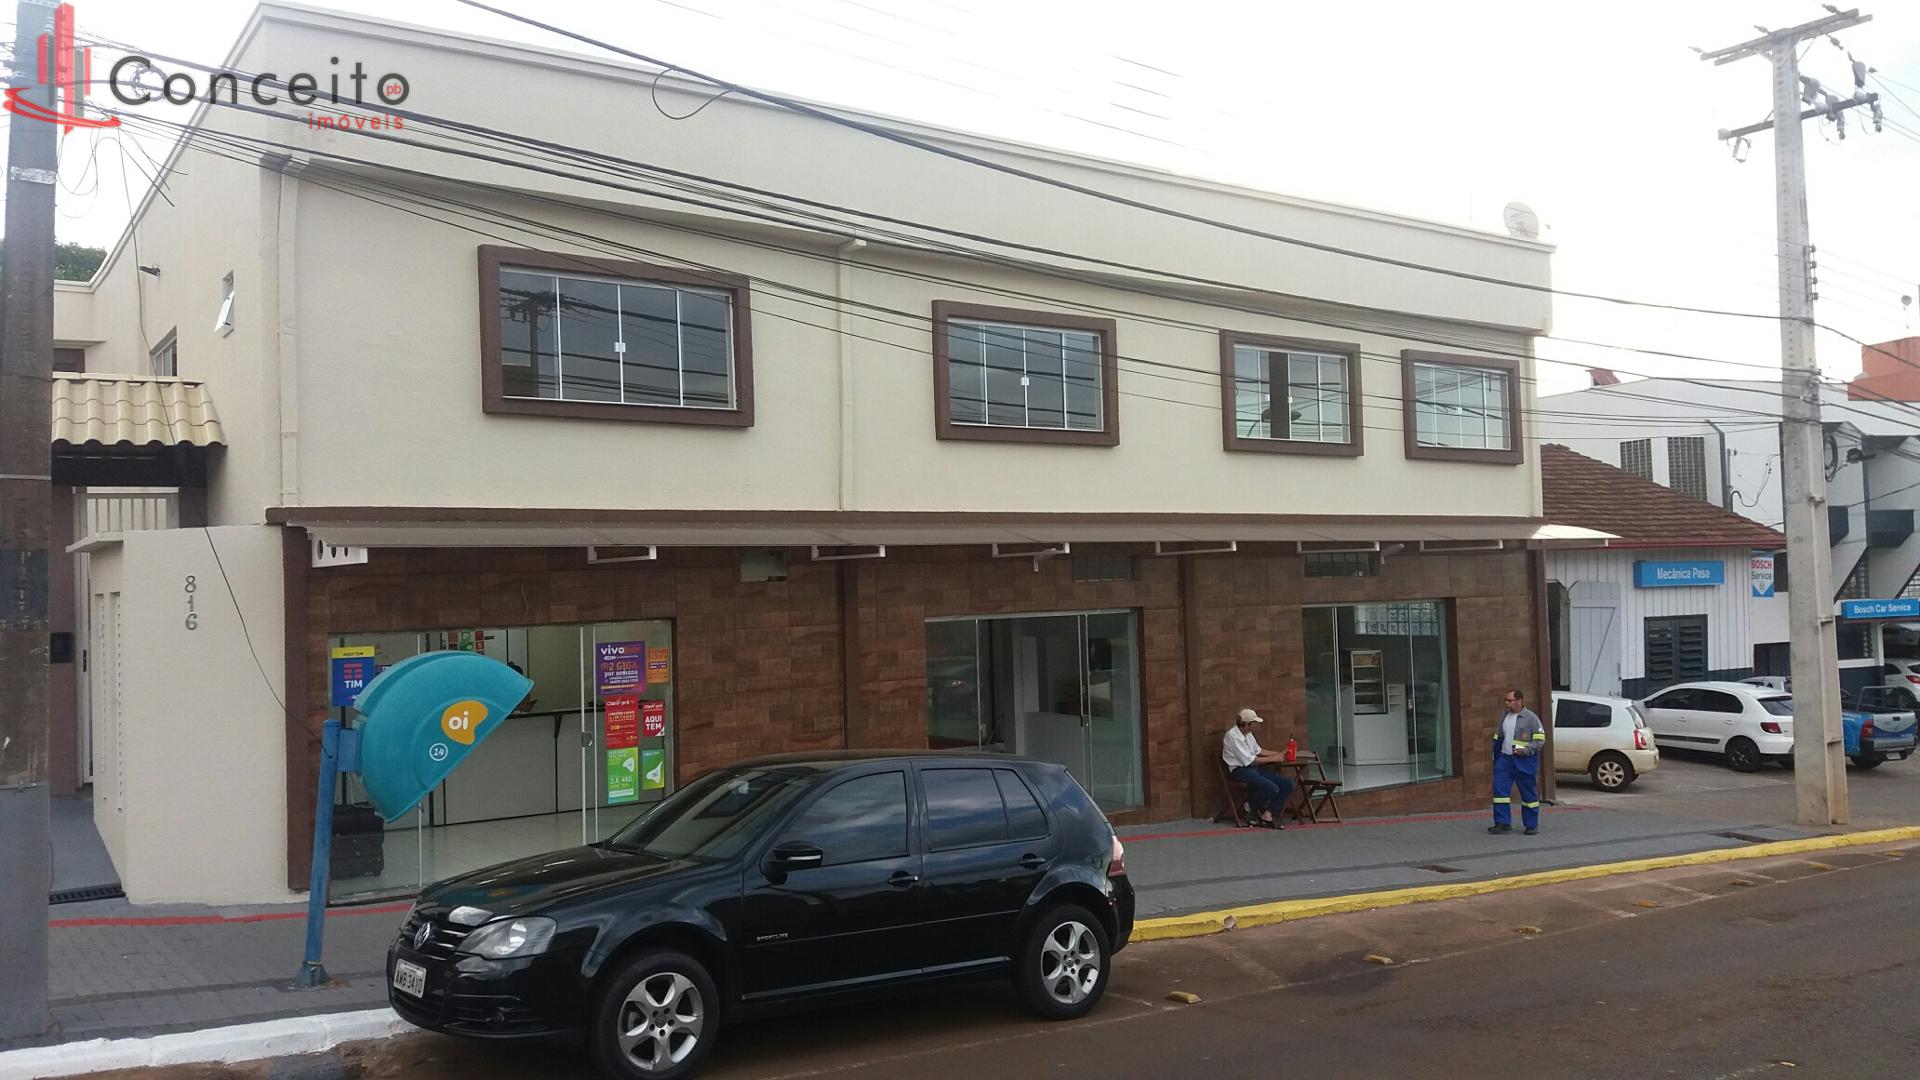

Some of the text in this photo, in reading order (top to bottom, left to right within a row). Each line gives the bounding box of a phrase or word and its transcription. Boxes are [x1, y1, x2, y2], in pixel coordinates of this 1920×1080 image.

[1752, 560, 1772, 570] BOSCH
[1656, 567, 1691, 580] Mecânica
[1752, 572, 1772, 580] Service
[1854, 603, 1911, 614] Bosch Car Service
[600, 645, 625, 655] vivo
[344, 680, 363, 688] TIM
[448, 710, 469, 730] oi
[645, 715, 662, 723] AQUI
[645, 723, 661, 731] TEM
